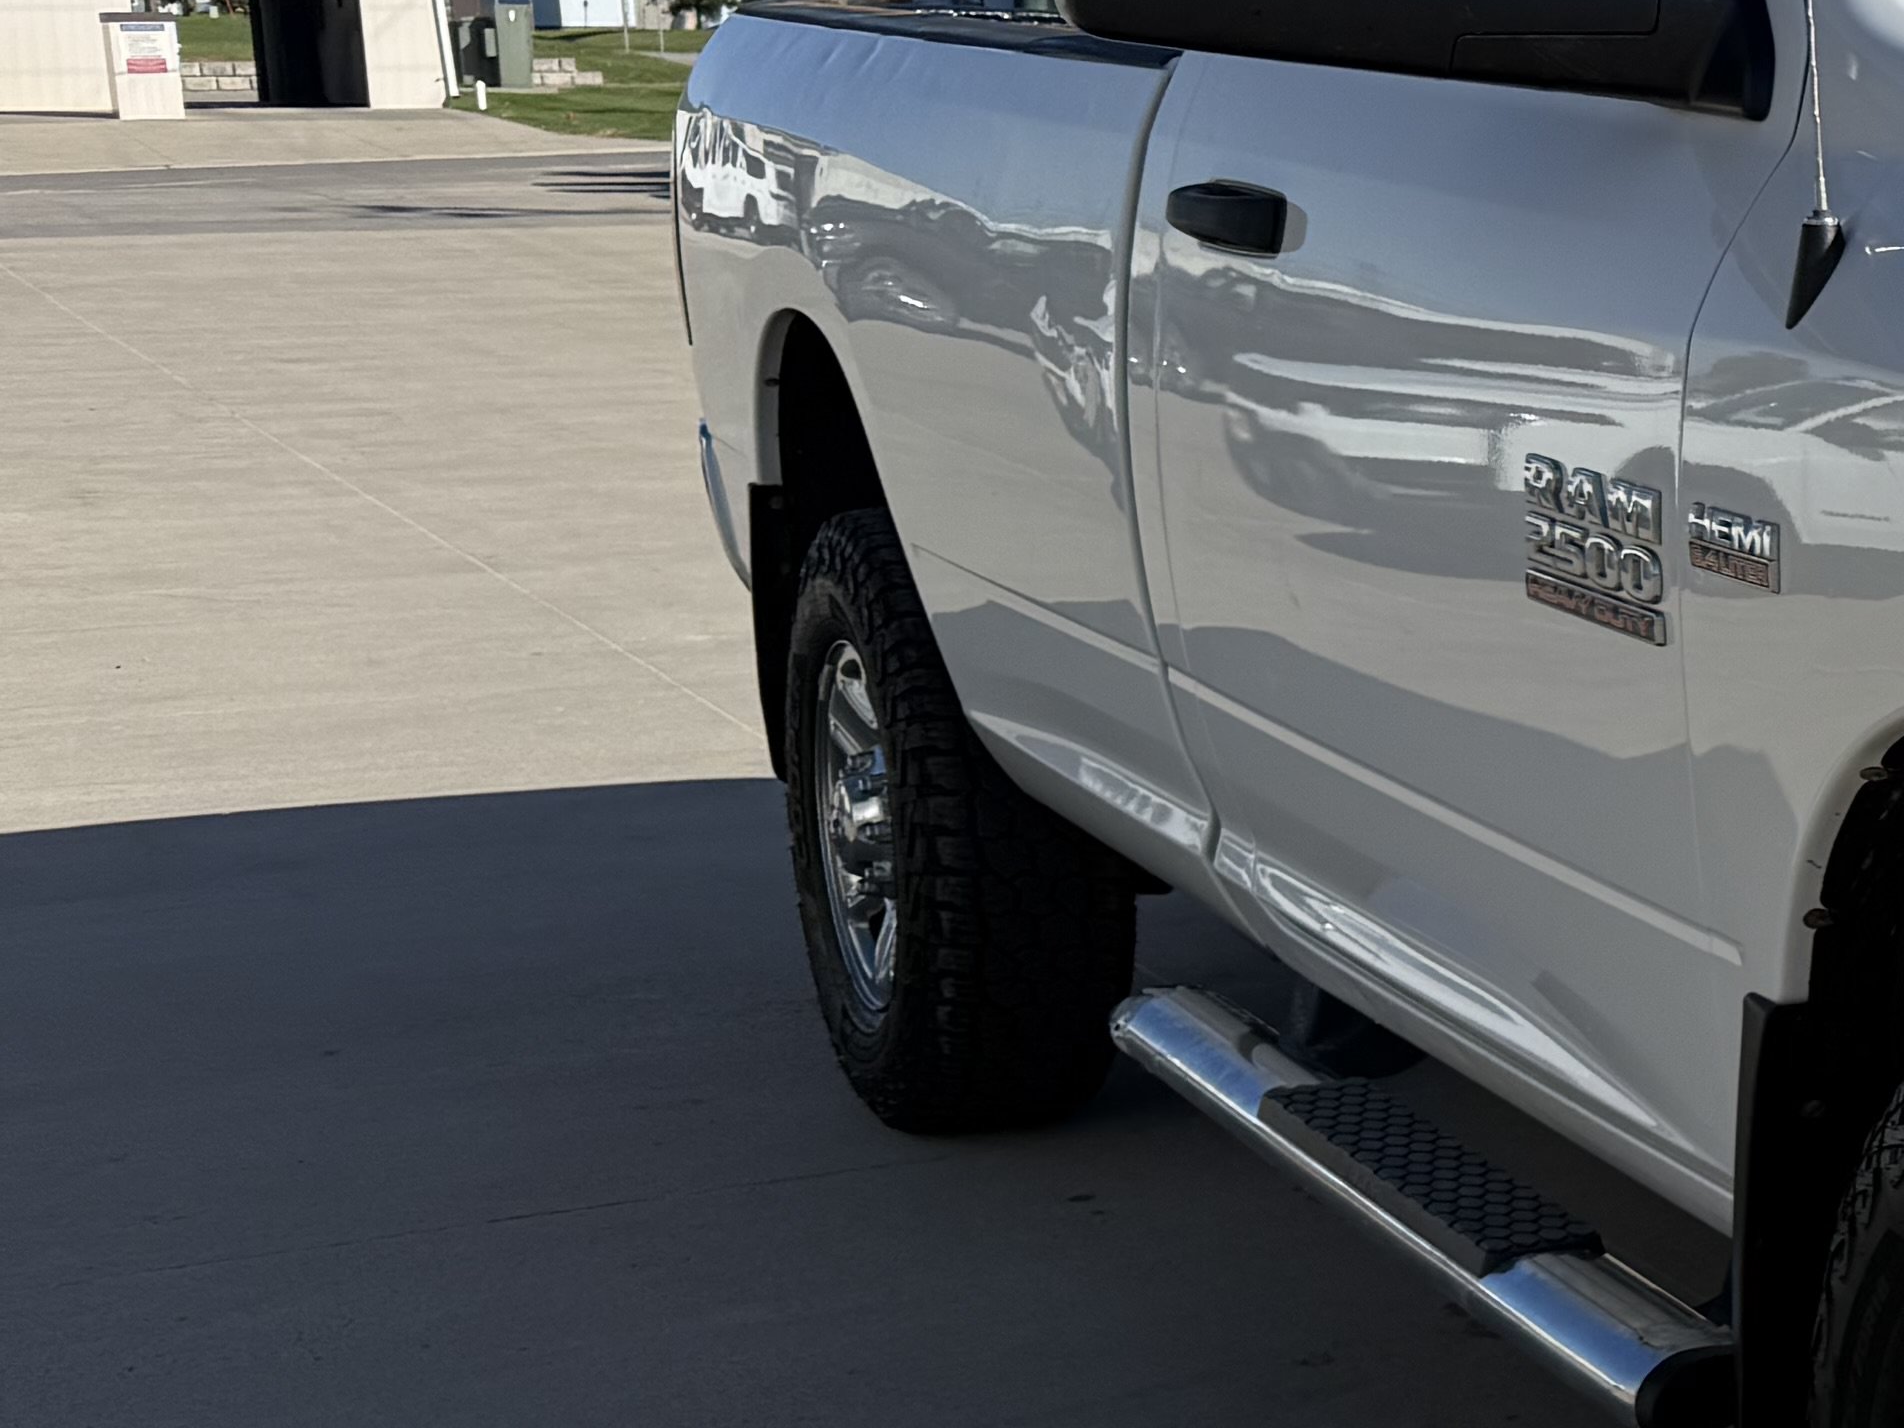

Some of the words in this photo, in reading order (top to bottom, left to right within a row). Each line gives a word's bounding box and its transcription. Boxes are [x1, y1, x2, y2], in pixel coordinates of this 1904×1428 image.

[1525, 452, 1664, 545] RAM
[1688, 502, 1778, 559] HEMI
[1525, 510, 1664, 605] 2500
[1529, 579, 1594, 614] HEAVY
[1594, 598, 1652, 638] DUTY
